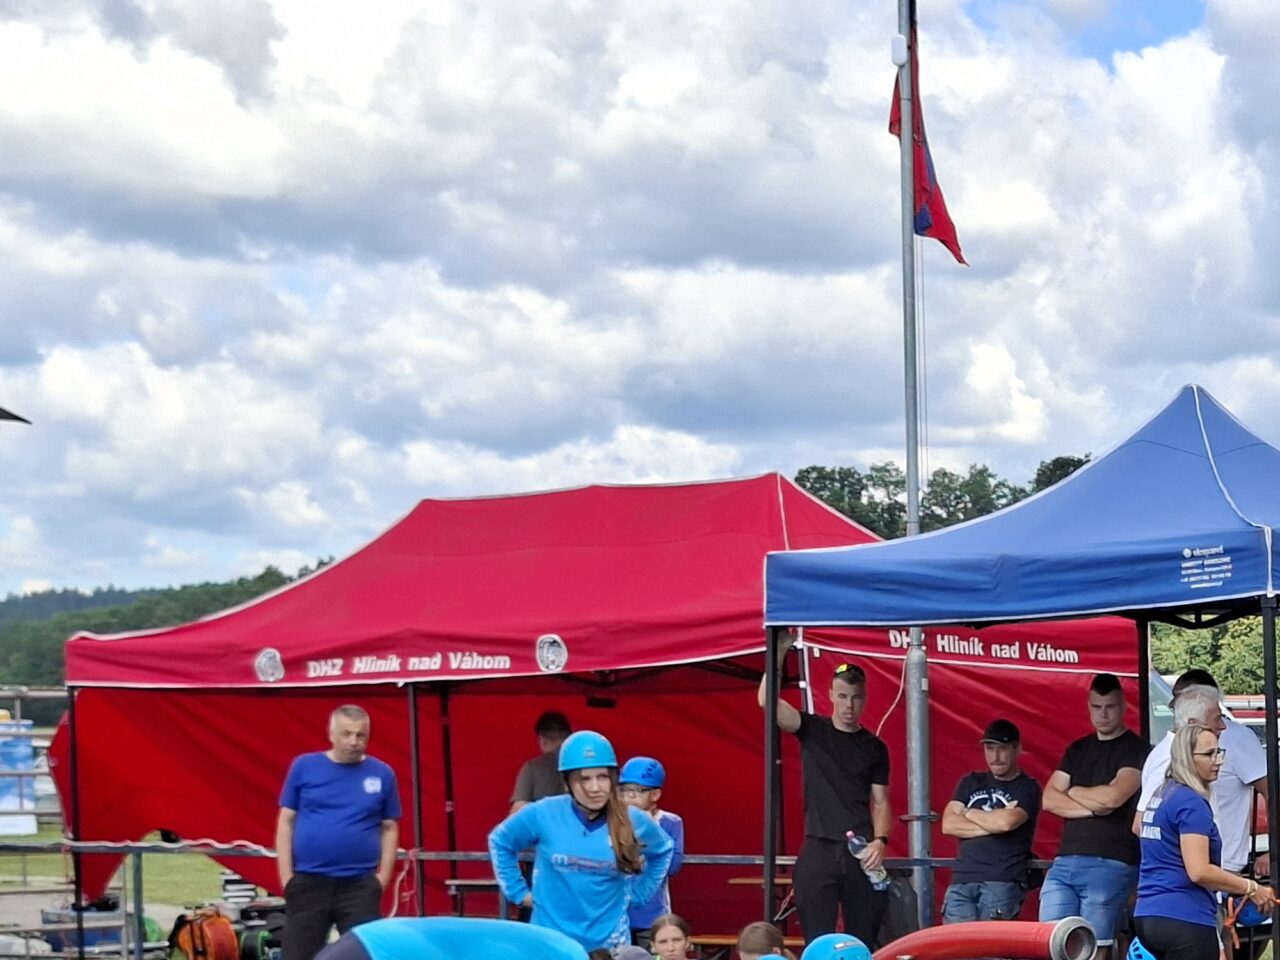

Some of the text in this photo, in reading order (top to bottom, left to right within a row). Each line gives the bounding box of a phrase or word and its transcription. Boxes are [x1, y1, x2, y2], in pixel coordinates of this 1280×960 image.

[889, 629, 1079, 663] DH Hliník nad Váhom
[307, 652, 511, 677] DHZ Hliník nad Váhom
